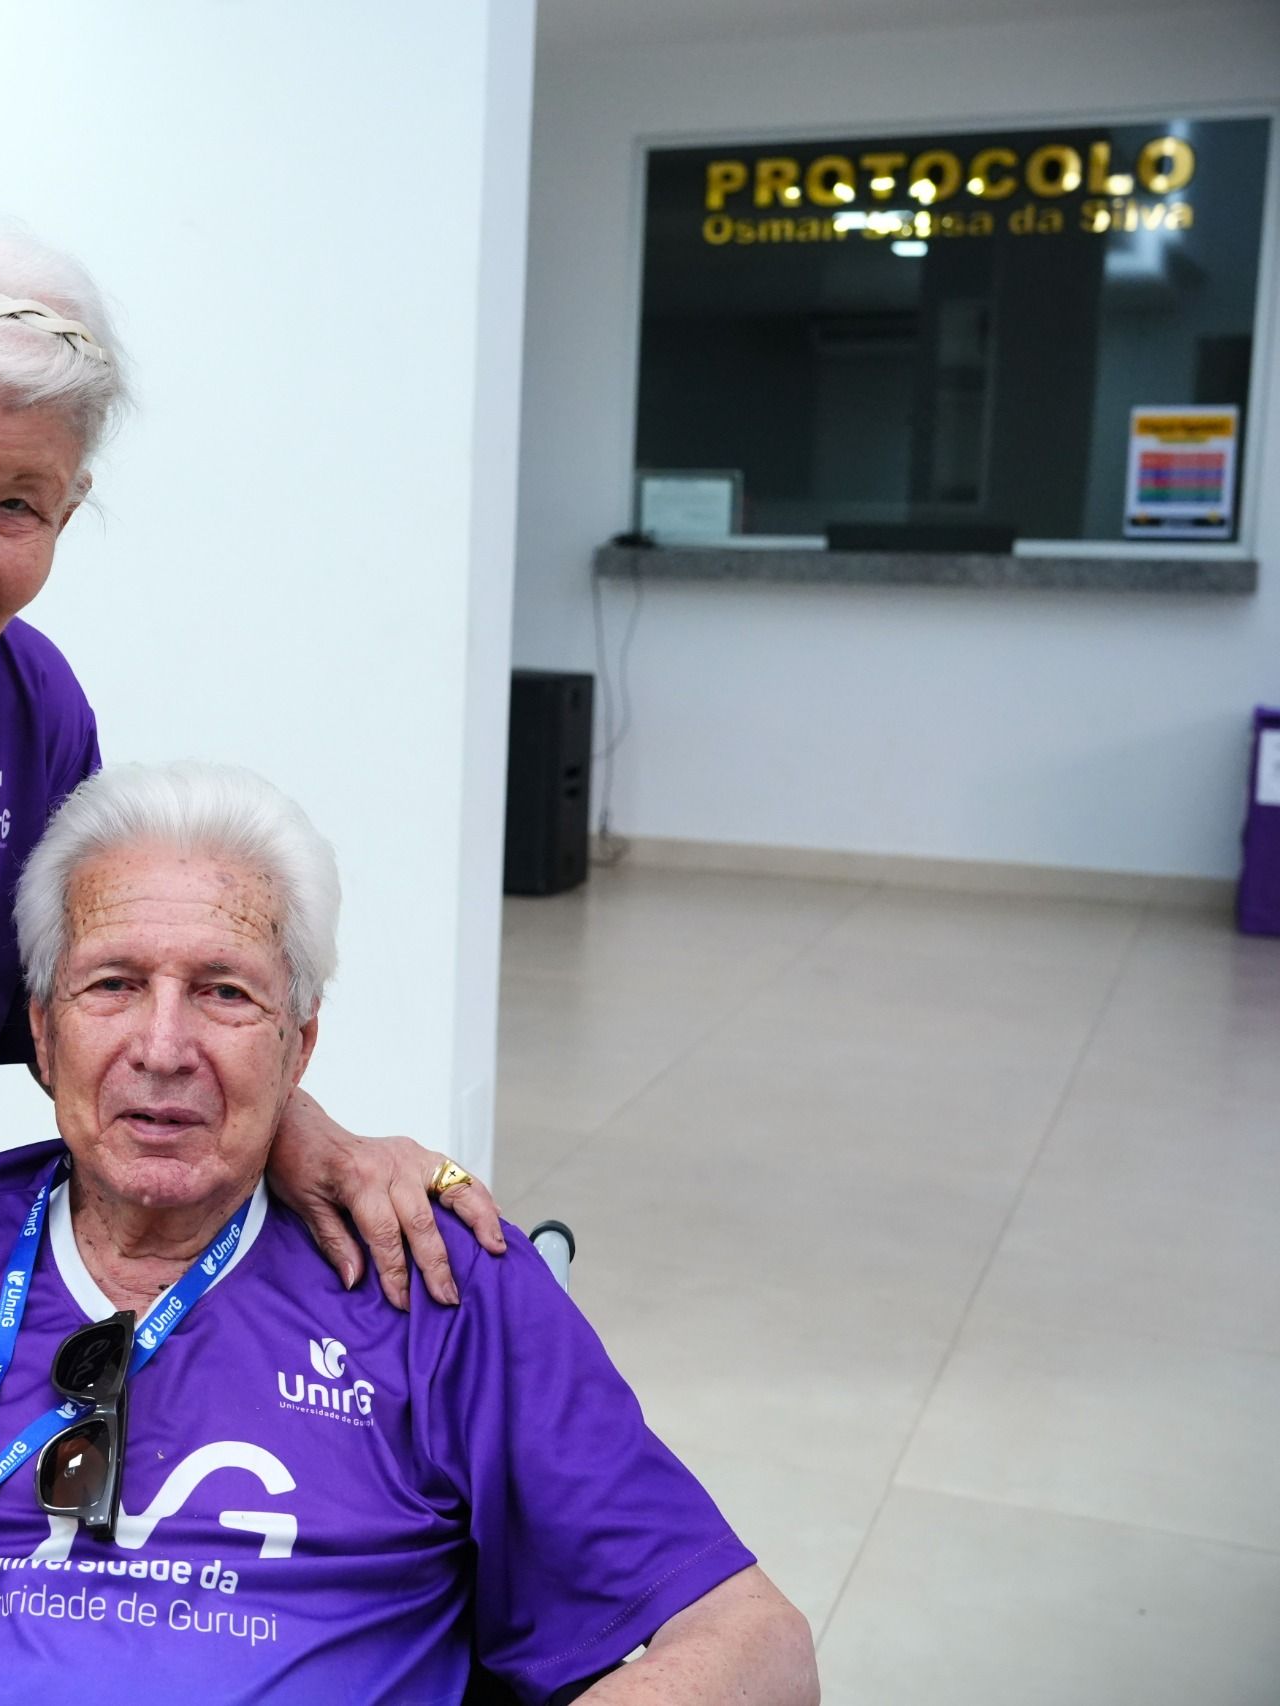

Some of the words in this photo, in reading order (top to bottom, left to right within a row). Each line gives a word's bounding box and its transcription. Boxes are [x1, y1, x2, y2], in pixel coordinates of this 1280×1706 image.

[706, 136, 1195, 209] PROTOCOLO
[703, 214, 847, 245] Osman
[1009, 202, 1063, 236] da
[1080, 199, 1194, 234] Silva
[279, 1401, 340, 1420] Universidade
[341, 1415, 352, 1424] de
[199, 1560, 239, 1594] da
[117, 1592, 157, 1627] de
[168, 1599, 277, 1647] Gurupi
